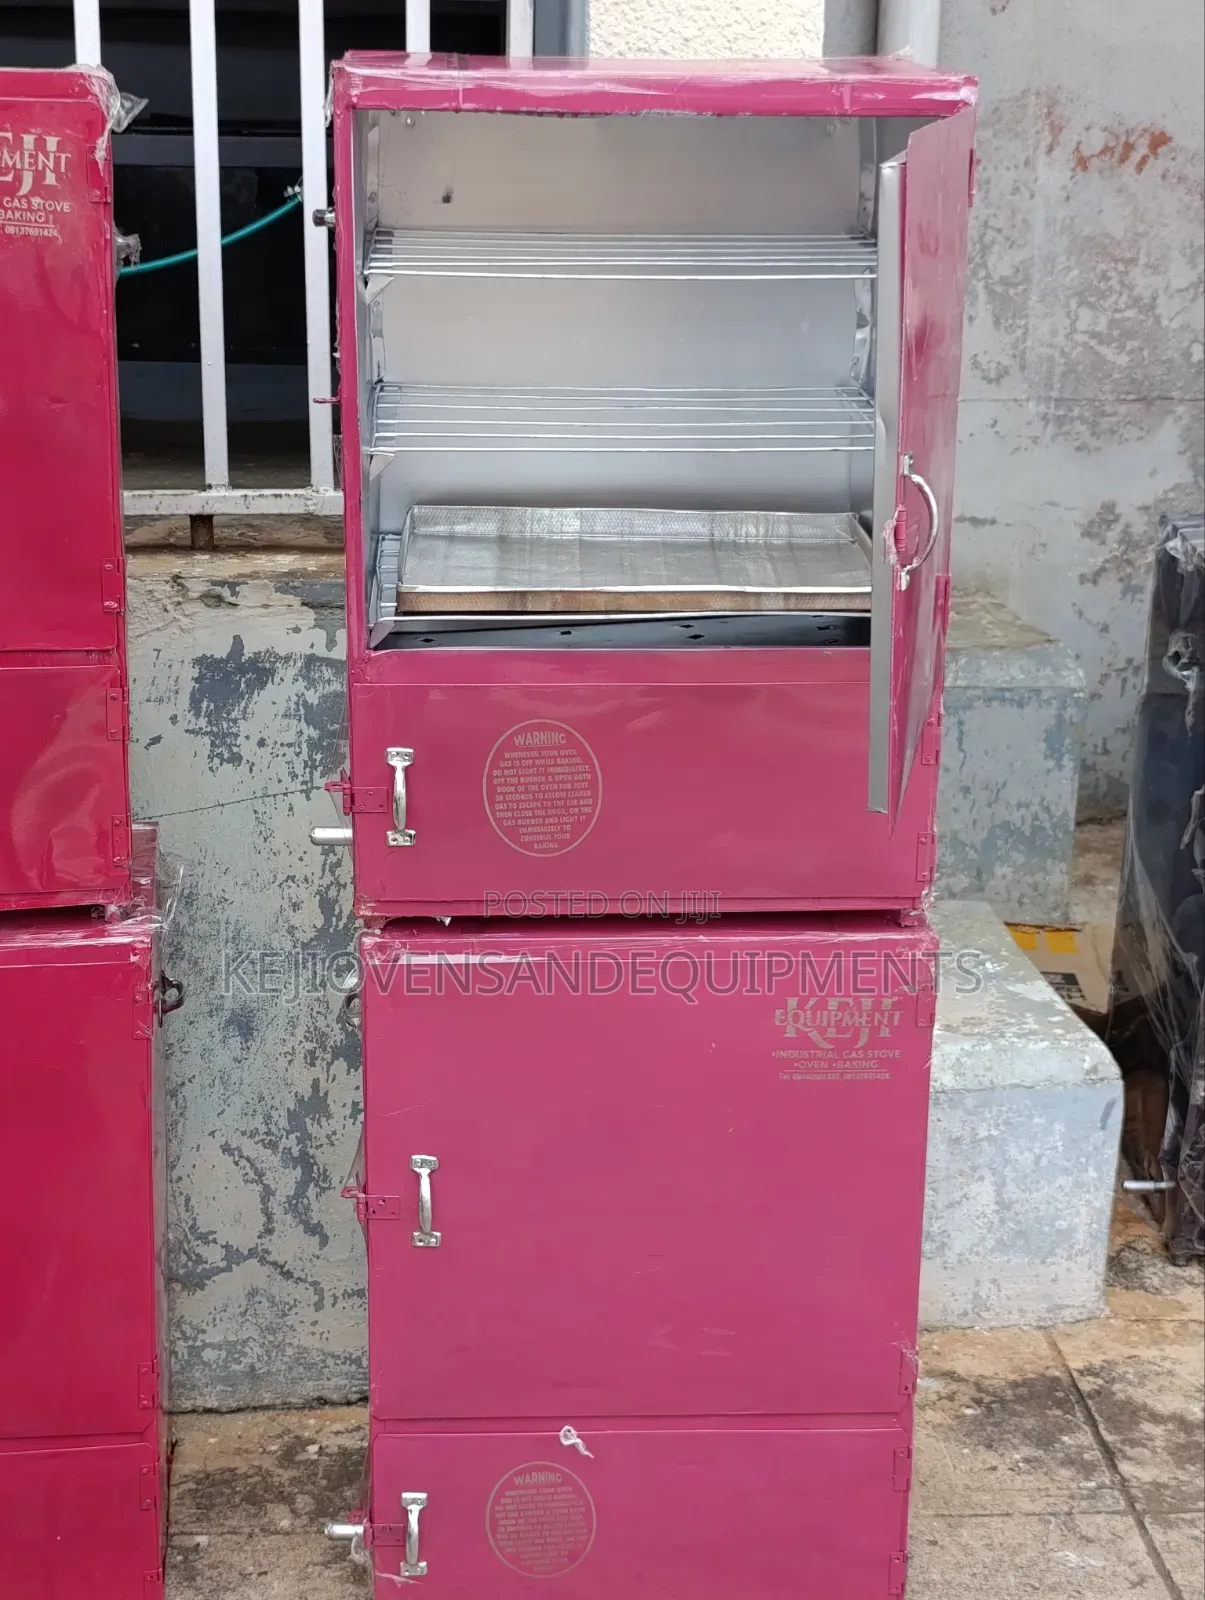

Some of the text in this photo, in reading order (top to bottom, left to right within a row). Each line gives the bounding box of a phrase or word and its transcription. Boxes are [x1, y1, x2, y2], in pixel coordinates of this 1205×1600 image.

[0, 148, 71, 173] MENT
[4, 197, 70, 212] GAS STOVE
[0, 209, 44, 222] BAKING
[514, 731, 566, 746] WARNING
[504, 751, 538, 759] WHENEVER
[520, 776, 546, 784] BURNER
[518, 818, 543, 826] BURNER
[774, 1009, 903, 1032] EQUIPMENT
[842, 1050, 864, 1058] GAS
[868, 1050, 900, 1058] STOVE
[514, 1472, 562, 1485] WARNING
